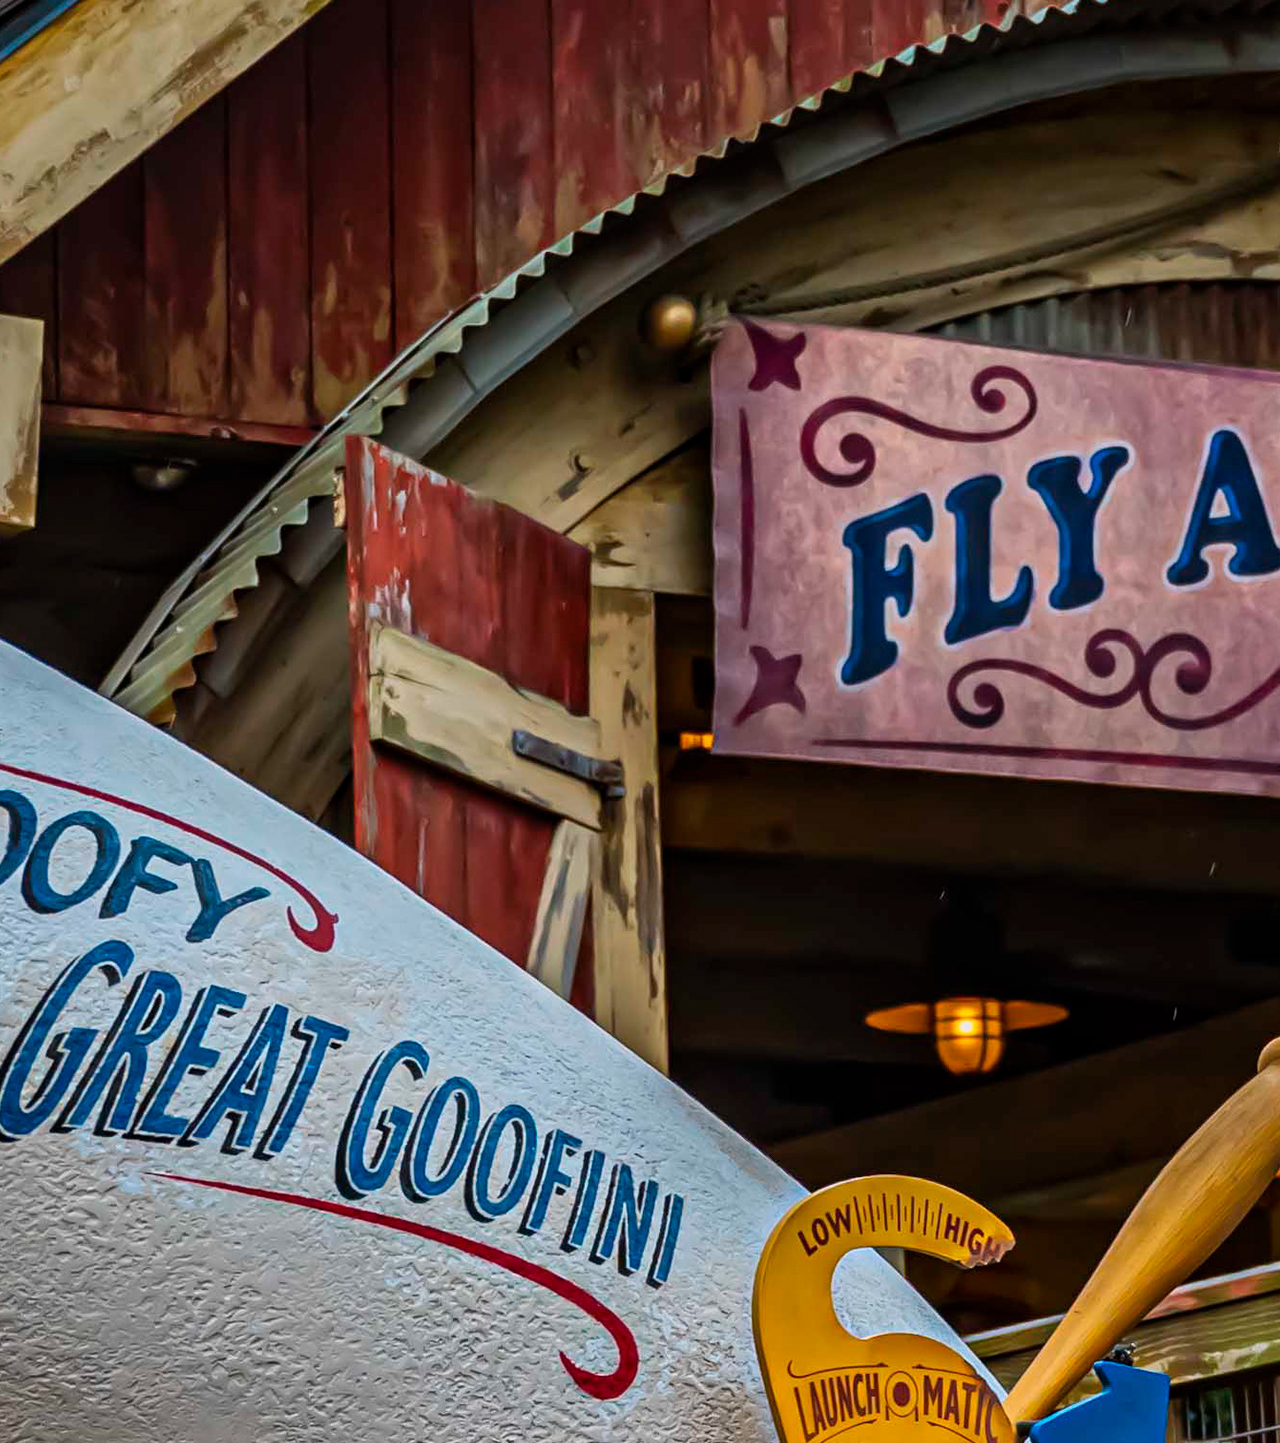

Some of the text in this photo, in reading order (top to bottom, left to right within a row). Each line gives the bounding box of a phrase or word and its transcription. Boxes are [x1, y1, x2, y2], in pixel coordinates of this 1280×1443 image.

[841, 445, 1129, 686] FLY
[336, 1039, 684, 1289] GOOFINI
[797, 1204, 1002, 1264] LOW HIGH
[794, 1373, 881, 1442] LAUNCH
